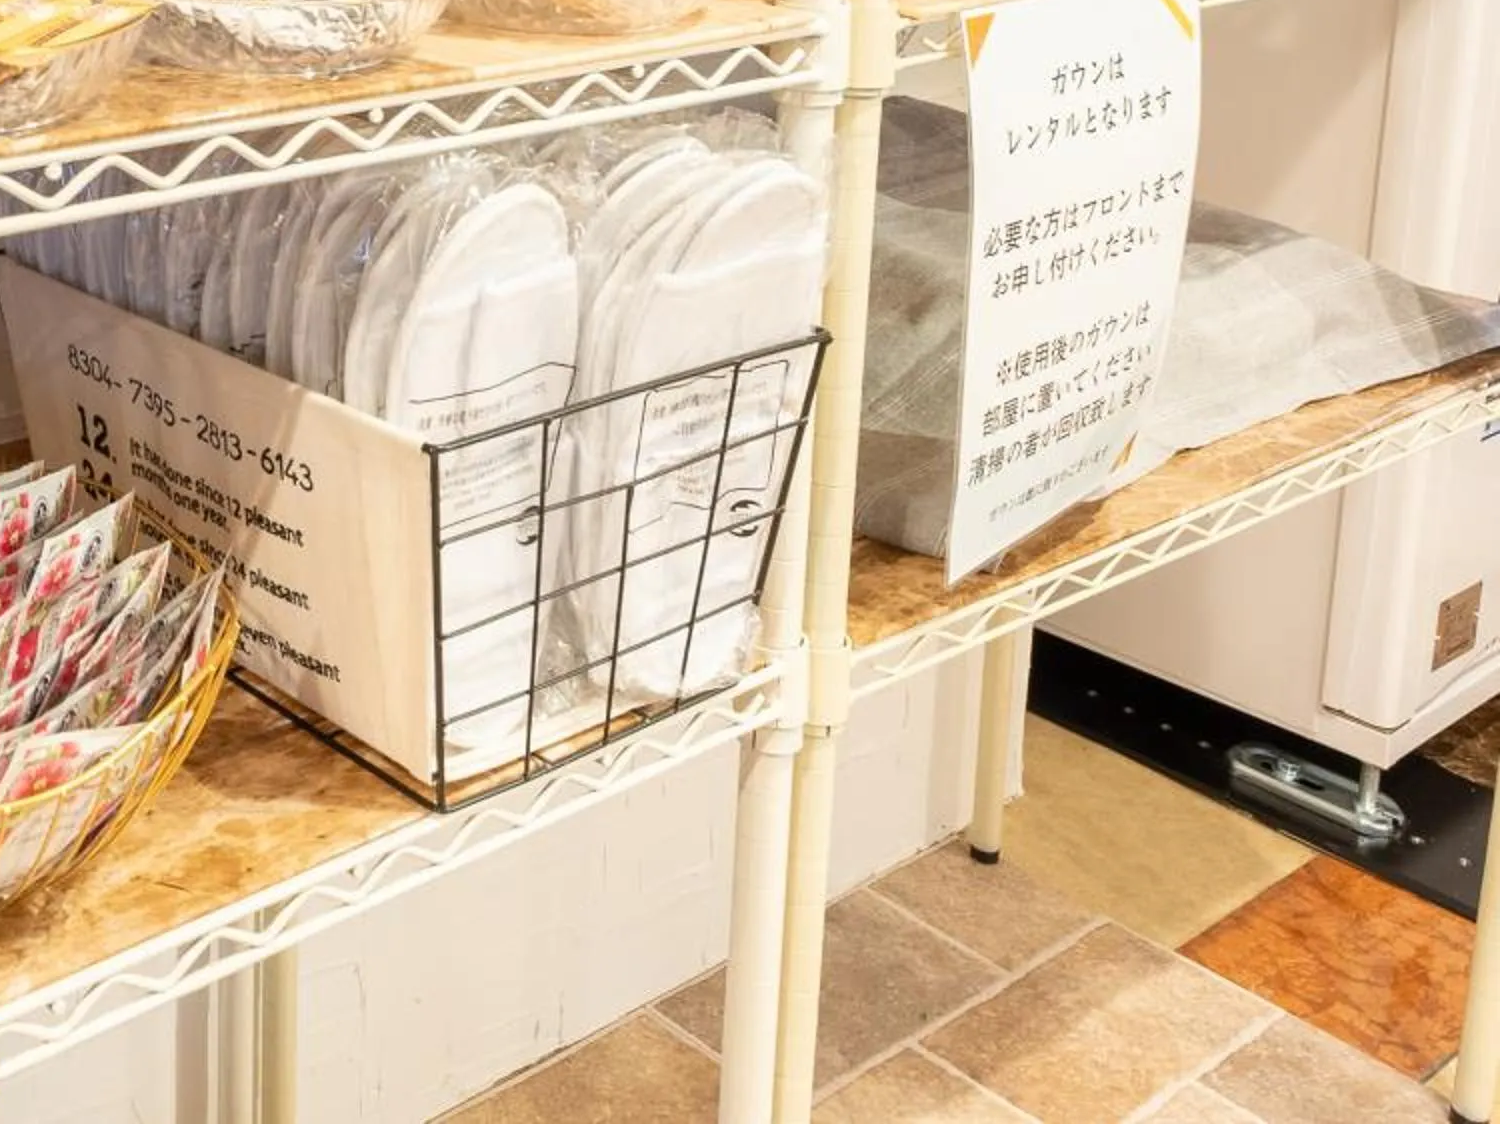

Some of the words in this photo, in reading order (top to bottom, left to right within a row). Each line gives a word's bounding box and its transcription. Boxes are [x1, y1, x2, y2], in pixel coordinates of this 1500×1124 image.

[1048, 51, 1126, 95] ガウンは
[1006, 85, 1173, 156] レンタルとなります
[983, 169, 1185, 260] 必要な方はフロントまで
[227, 495, 243, 519] 12
[244, 506, 305, 549] pleasant
[249, 566, 311, 611] pleasant
[277, 638, 341, 683] pleasant
